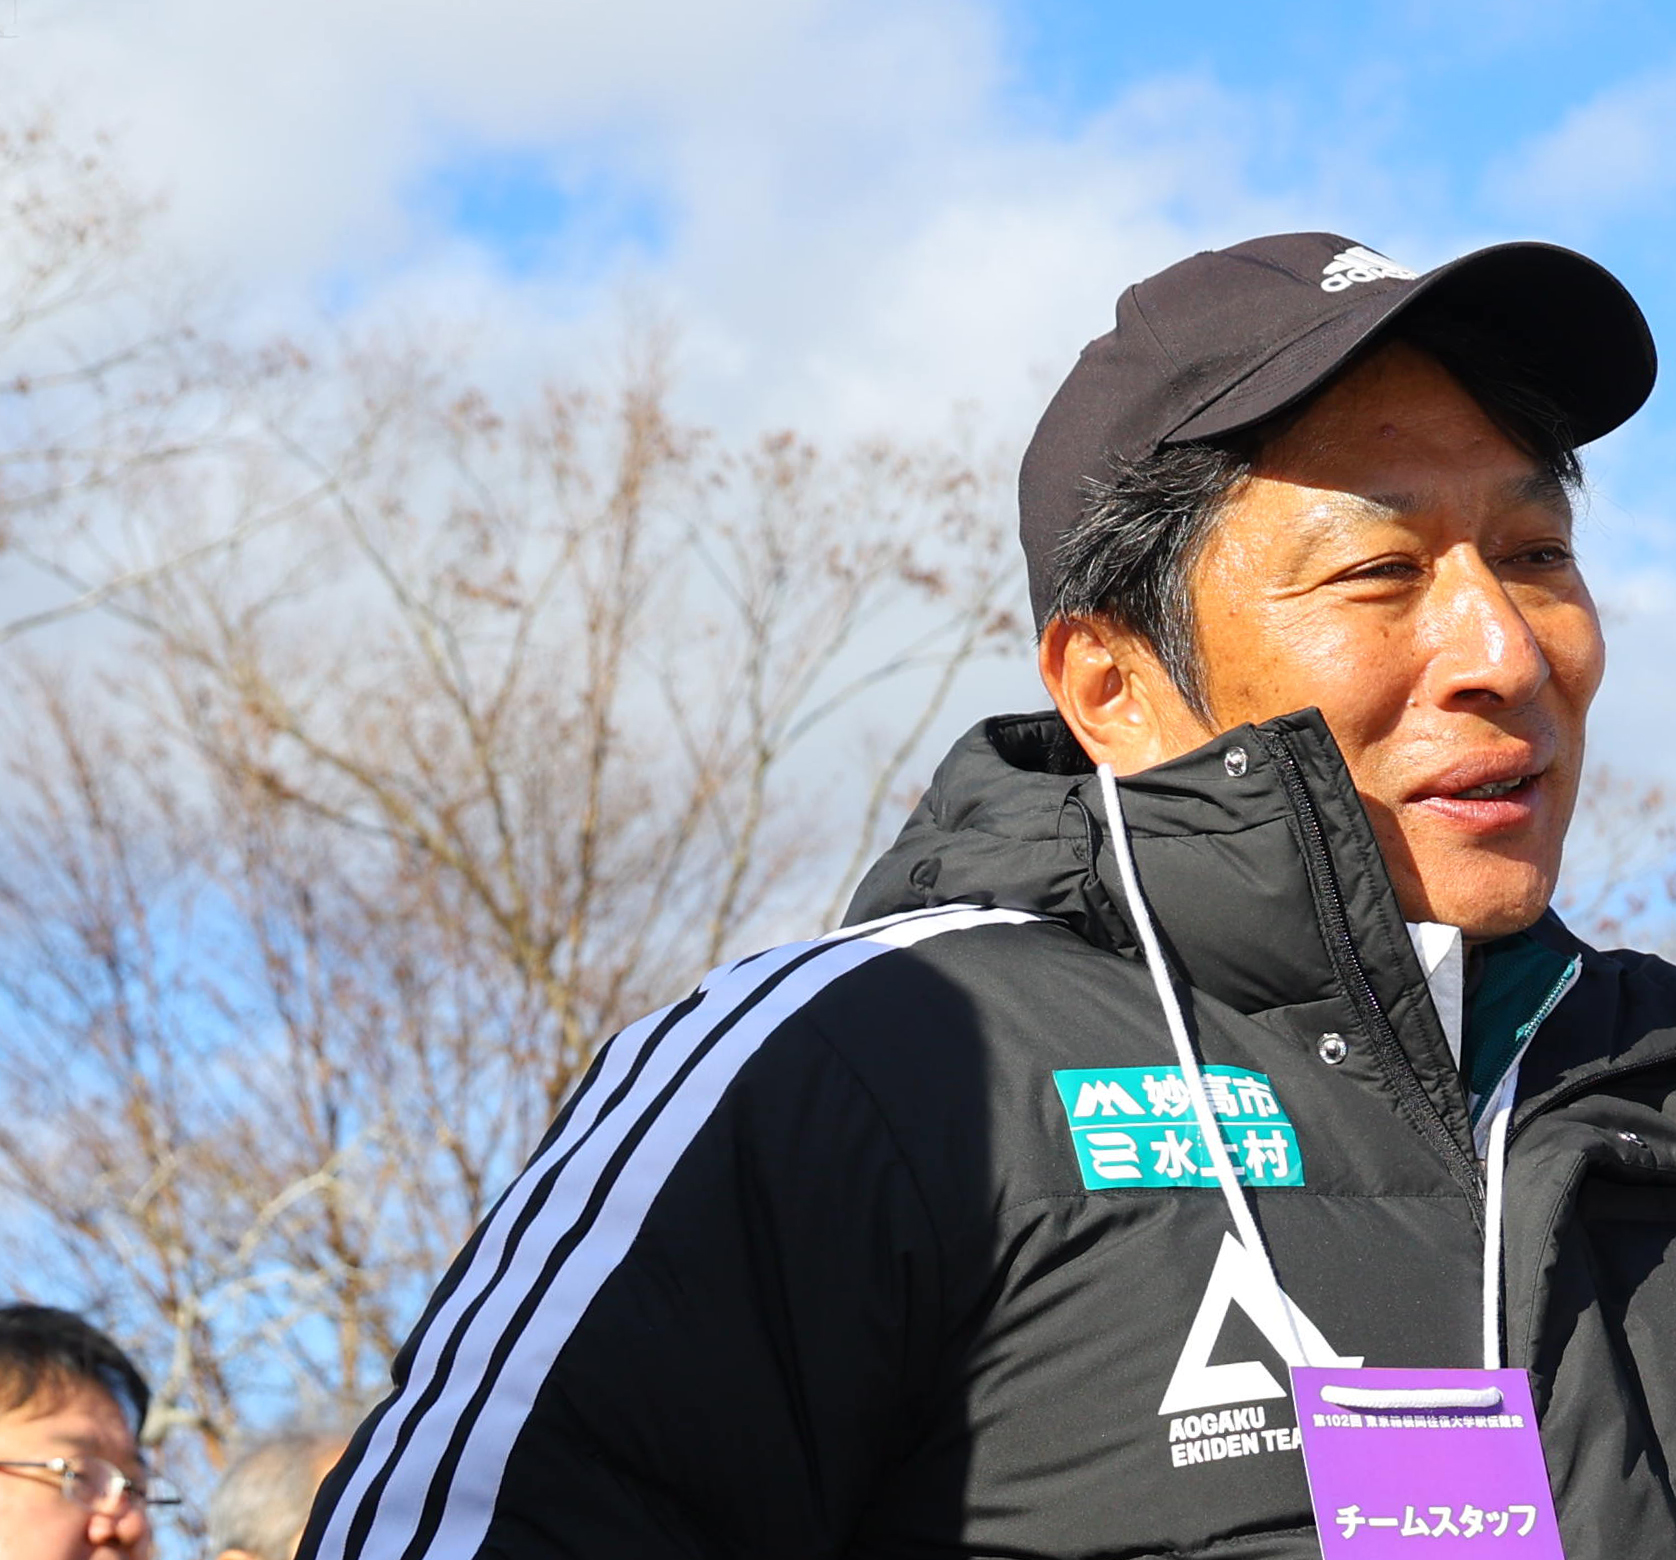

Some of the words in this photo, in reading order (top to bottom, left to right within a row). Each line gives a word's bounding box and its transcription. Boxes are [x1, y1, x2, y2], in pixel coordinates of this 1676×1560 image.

[1142, 1073, 1280, 1118] 妙高市
[1150, 1129, 1289, 1179] 水上村
[1169, 1406, 1266, 1443] AOGAKU
[1312, 1414, 1363, 1428] 第102回
[1170, 1432, 1260, 1468] EKIDEN
[1335, 1504, 1537, 1540] チームスタッフ
